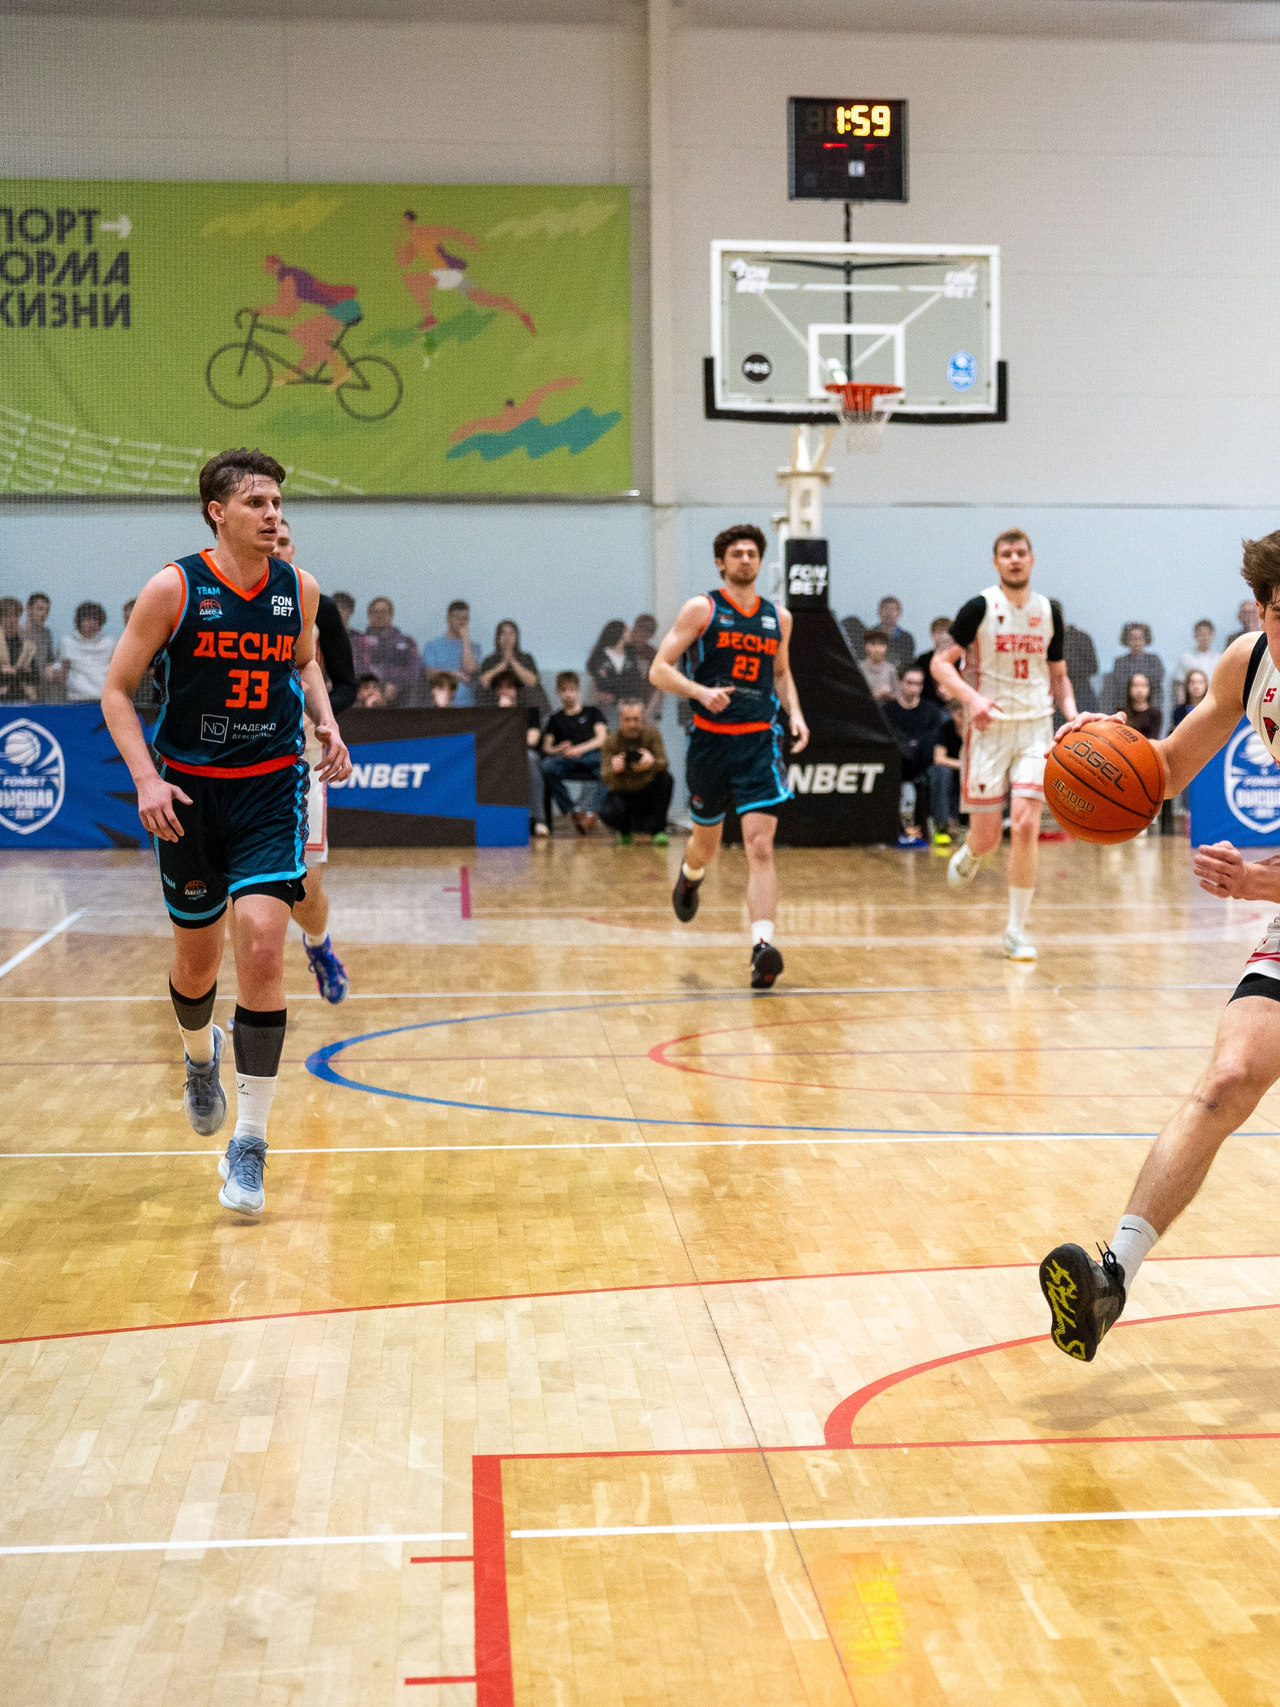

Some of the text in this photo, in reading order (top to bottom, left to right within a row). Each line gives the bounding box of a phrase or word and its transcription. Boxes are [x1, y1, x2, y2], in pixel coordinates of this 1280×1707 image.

[836, 105, 891, 137] 1:59
[196, 586, 221, 596] TEAM
[789, 579, 828, 596] BET
[271, 595, 293, 607] FON
[273, 605, 294, 618] BET
[193, 631, 295, 663] ДЕСНА
[731, 654, 760, 682] 23
[1013, 659, 1029, 679] 13
[225, 669, 270, 710] 33
